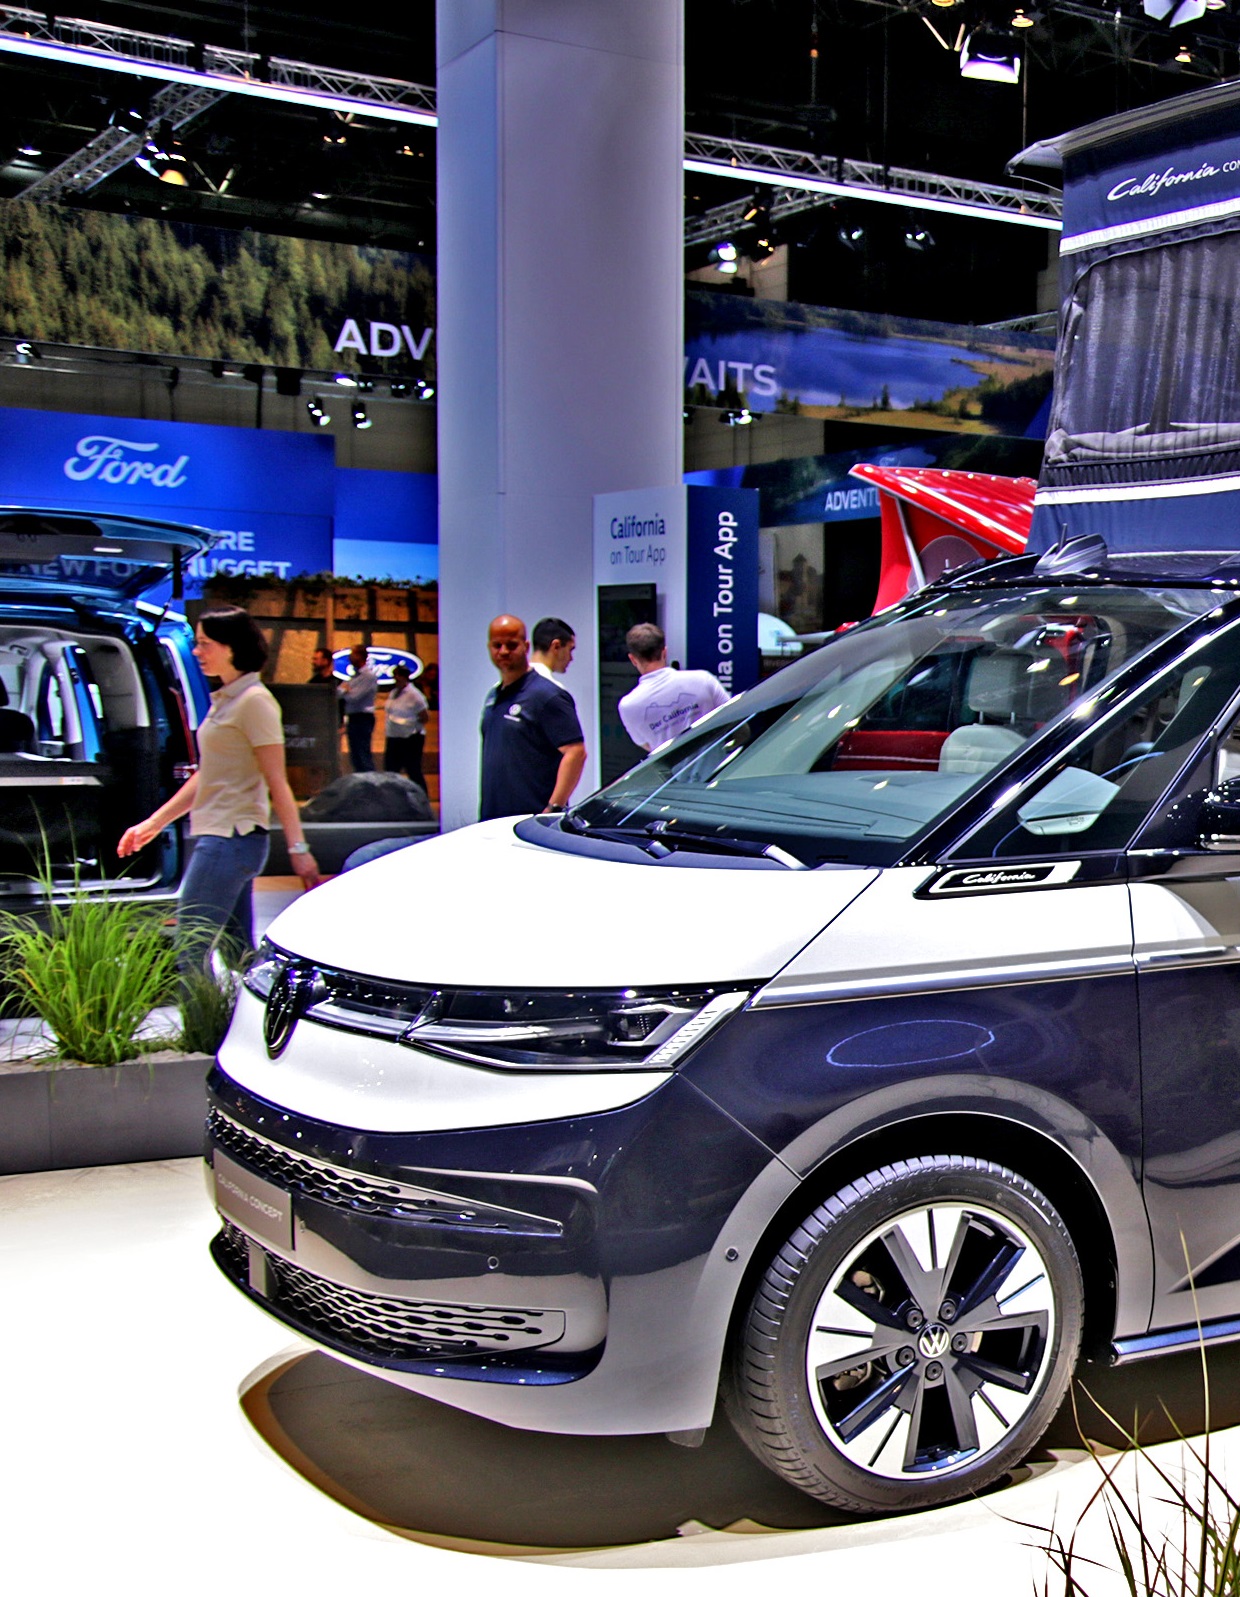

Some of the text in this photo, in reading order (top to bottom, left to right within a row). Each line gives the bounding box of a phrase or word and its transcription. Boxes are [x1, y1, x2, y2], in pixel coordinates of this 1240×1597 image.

[1107, 162, 1220, 201] California
[684, 357, 778, 396] AITS
[64, 435, 190, 488] Ford
[610, 513, 665, 539] California
[714, 511, 738, 560] App
[610, 544, 665, 565] on Tour App
[714, 564, 734, 617] Tour
[718, 624, 734, 655] on
[662, 703, 698, 723] California
[962, 872, 1036, 884] California
[250, 1195, 283, 1221] CONCEPT
